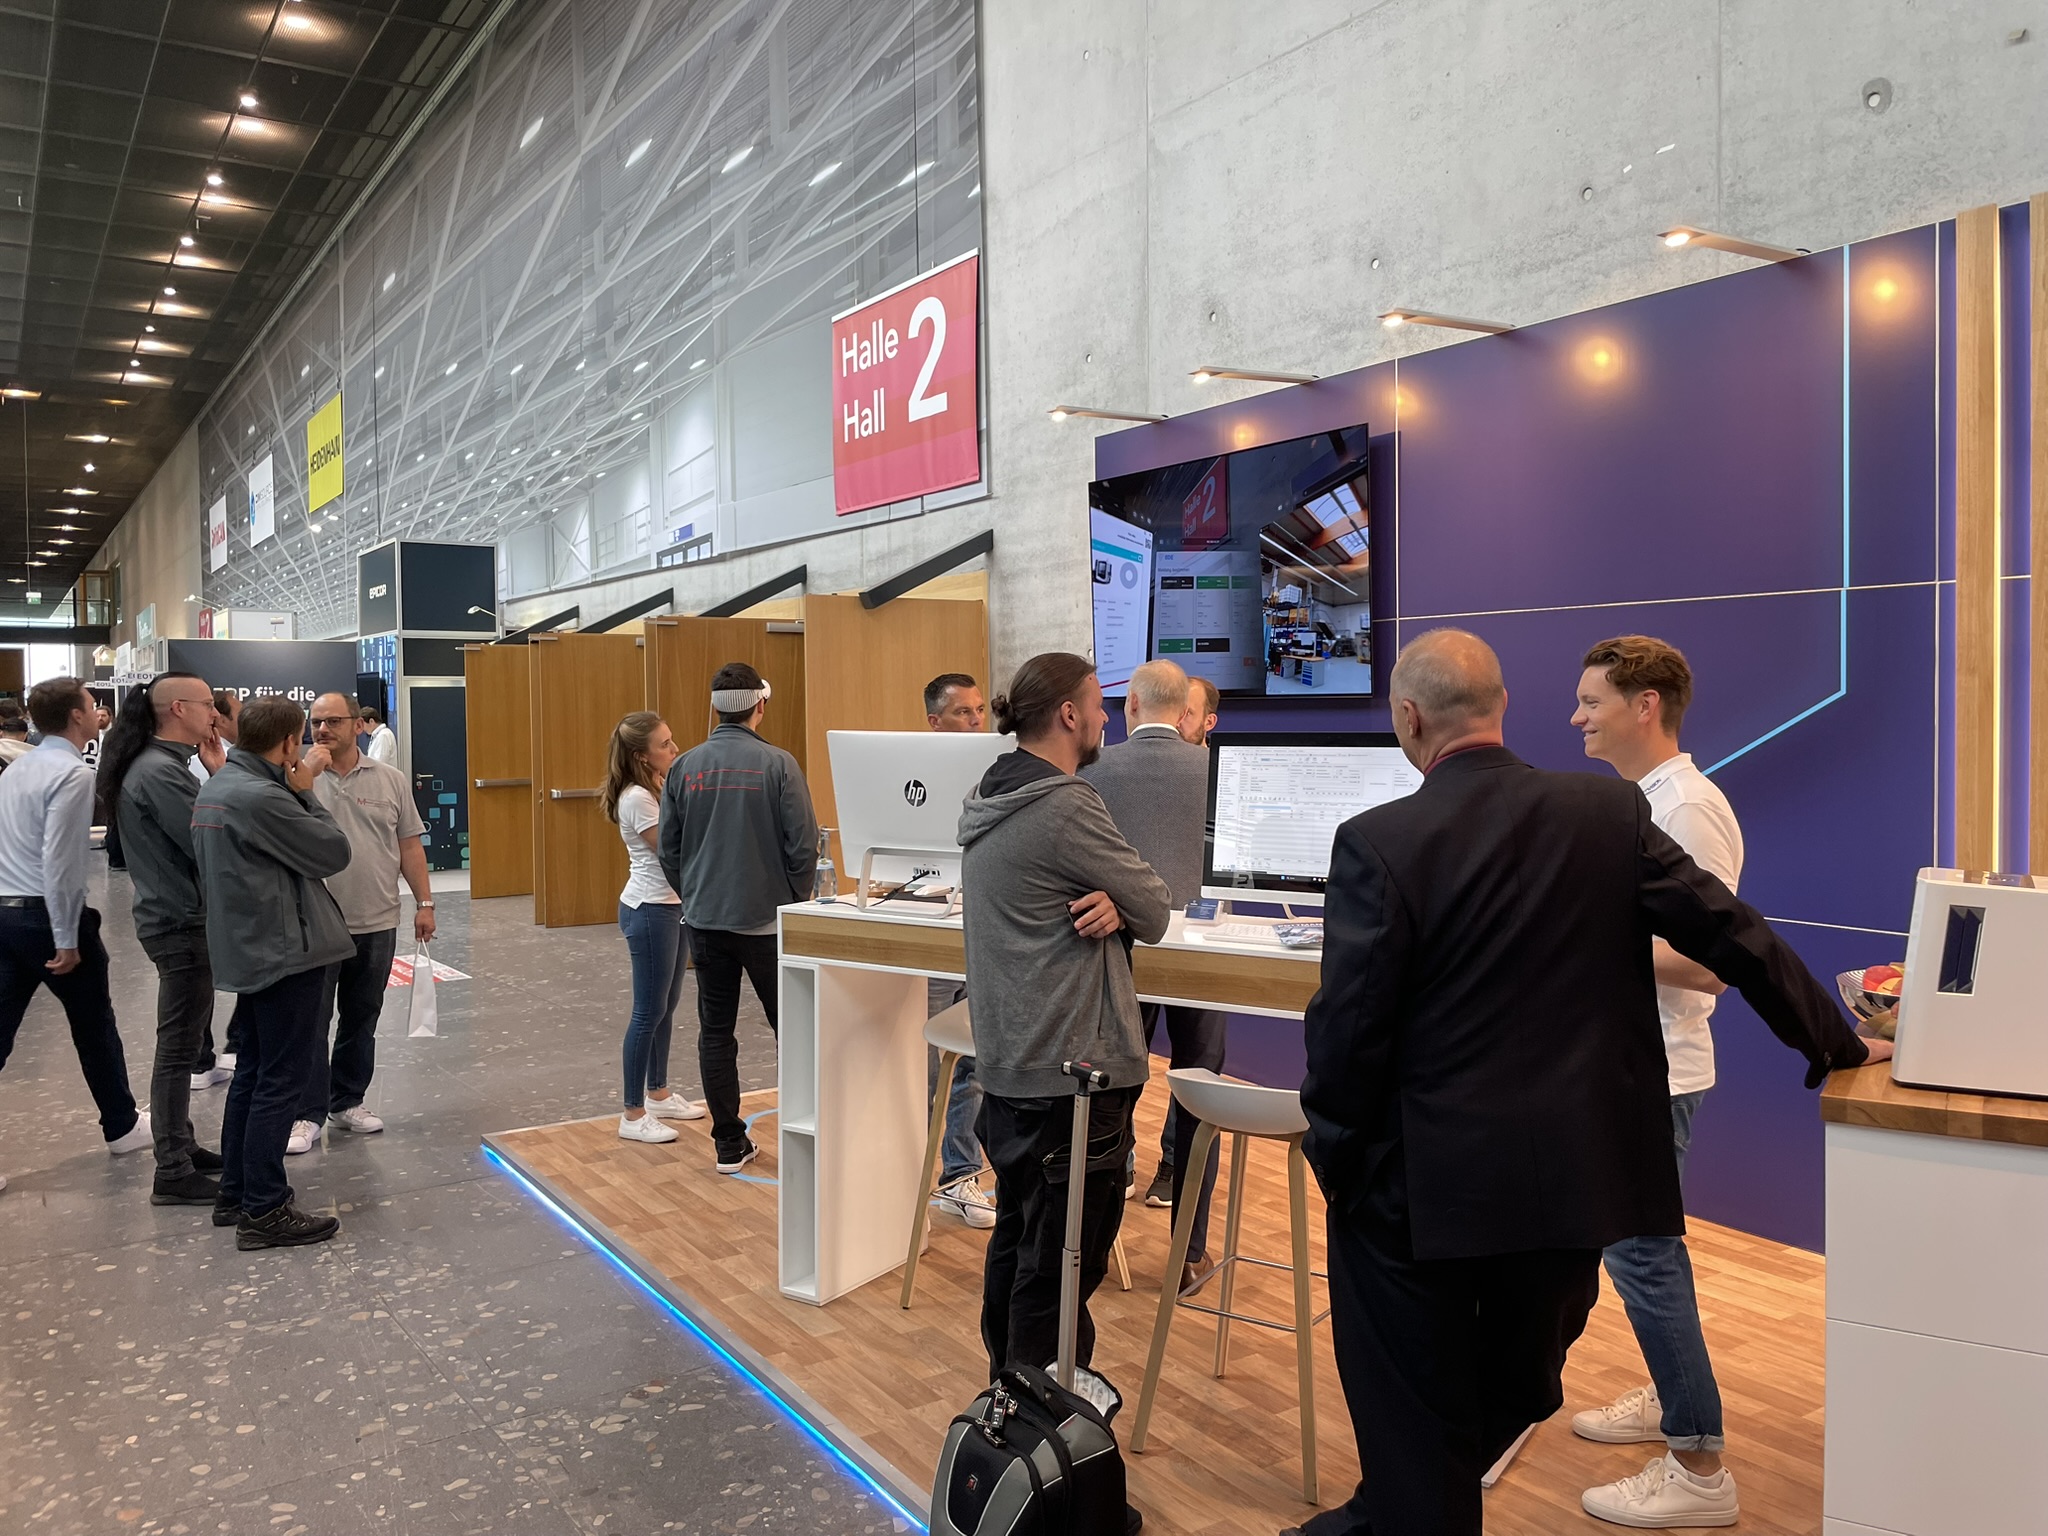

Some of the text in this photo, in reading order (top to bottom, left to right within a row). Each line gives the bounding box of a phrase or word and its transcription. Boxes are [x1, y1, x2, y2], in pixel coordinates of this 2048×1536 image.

[842, 296, 948, 423] Halle 2
[843, 387, 885, 443] Hall
[1203, 476, 1216, 523] 2
[288, 686, 315, 701] die
[905, 779, 926, 807] hp
